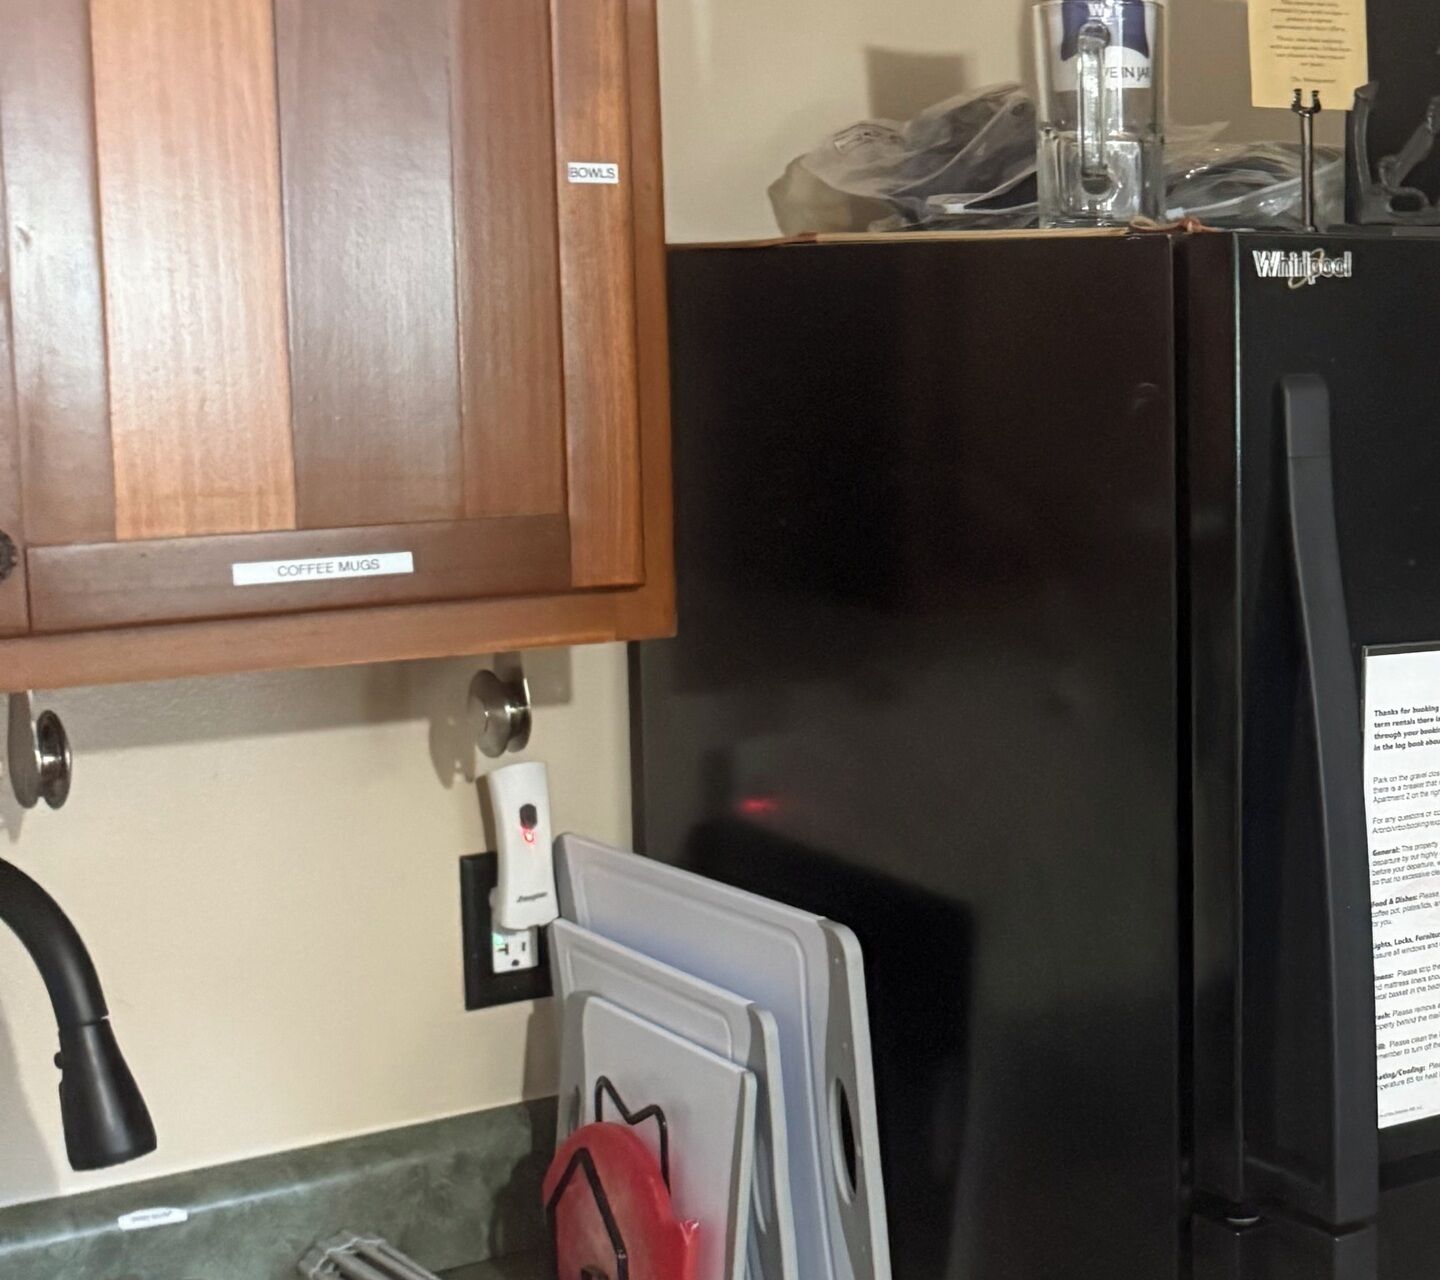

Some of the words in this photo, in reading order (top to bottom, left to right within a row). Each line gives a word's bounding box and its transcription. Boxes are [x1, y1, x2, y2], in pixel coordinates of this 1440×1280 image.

[568, 167, 616, 179] BOWLS
[1252, 249, 1352, 286] Whirlpool
[277, 562, 334, 577] COFFEE
[338, 558, 380, 572] MUGS
[1373, 744, 1380, 752] in
[1382, 743, 1393, 751] the
[1394, 742, 1406, 750] log
[1407, 740, 1424, 748] book
